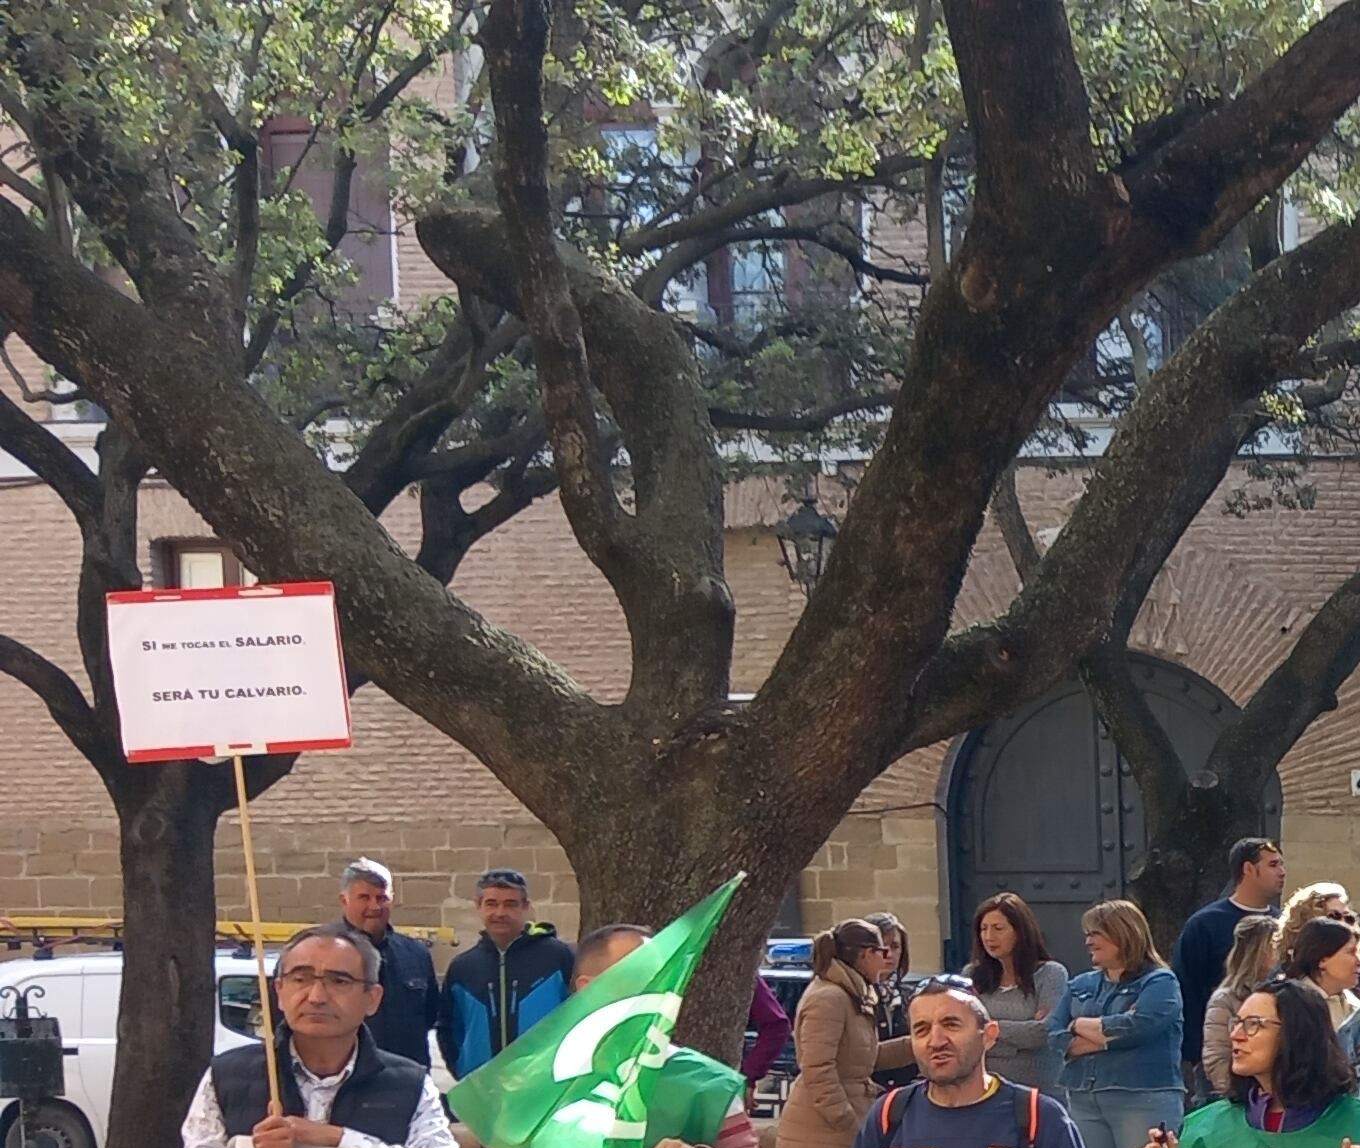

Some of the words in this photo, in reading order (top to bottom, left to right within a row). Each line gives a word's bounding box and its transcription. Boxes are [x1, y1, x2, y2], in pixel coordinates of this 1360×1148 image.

[142, 640, 157, 651] SI
[181, 641, 216, 650] TOCAS
[219, 640, 231, 649] EL
[152, 688, 194, 702] SERÁ
[198, 688, 219, 700] TU
[224, 685, 307, 699] CALVARIO.
